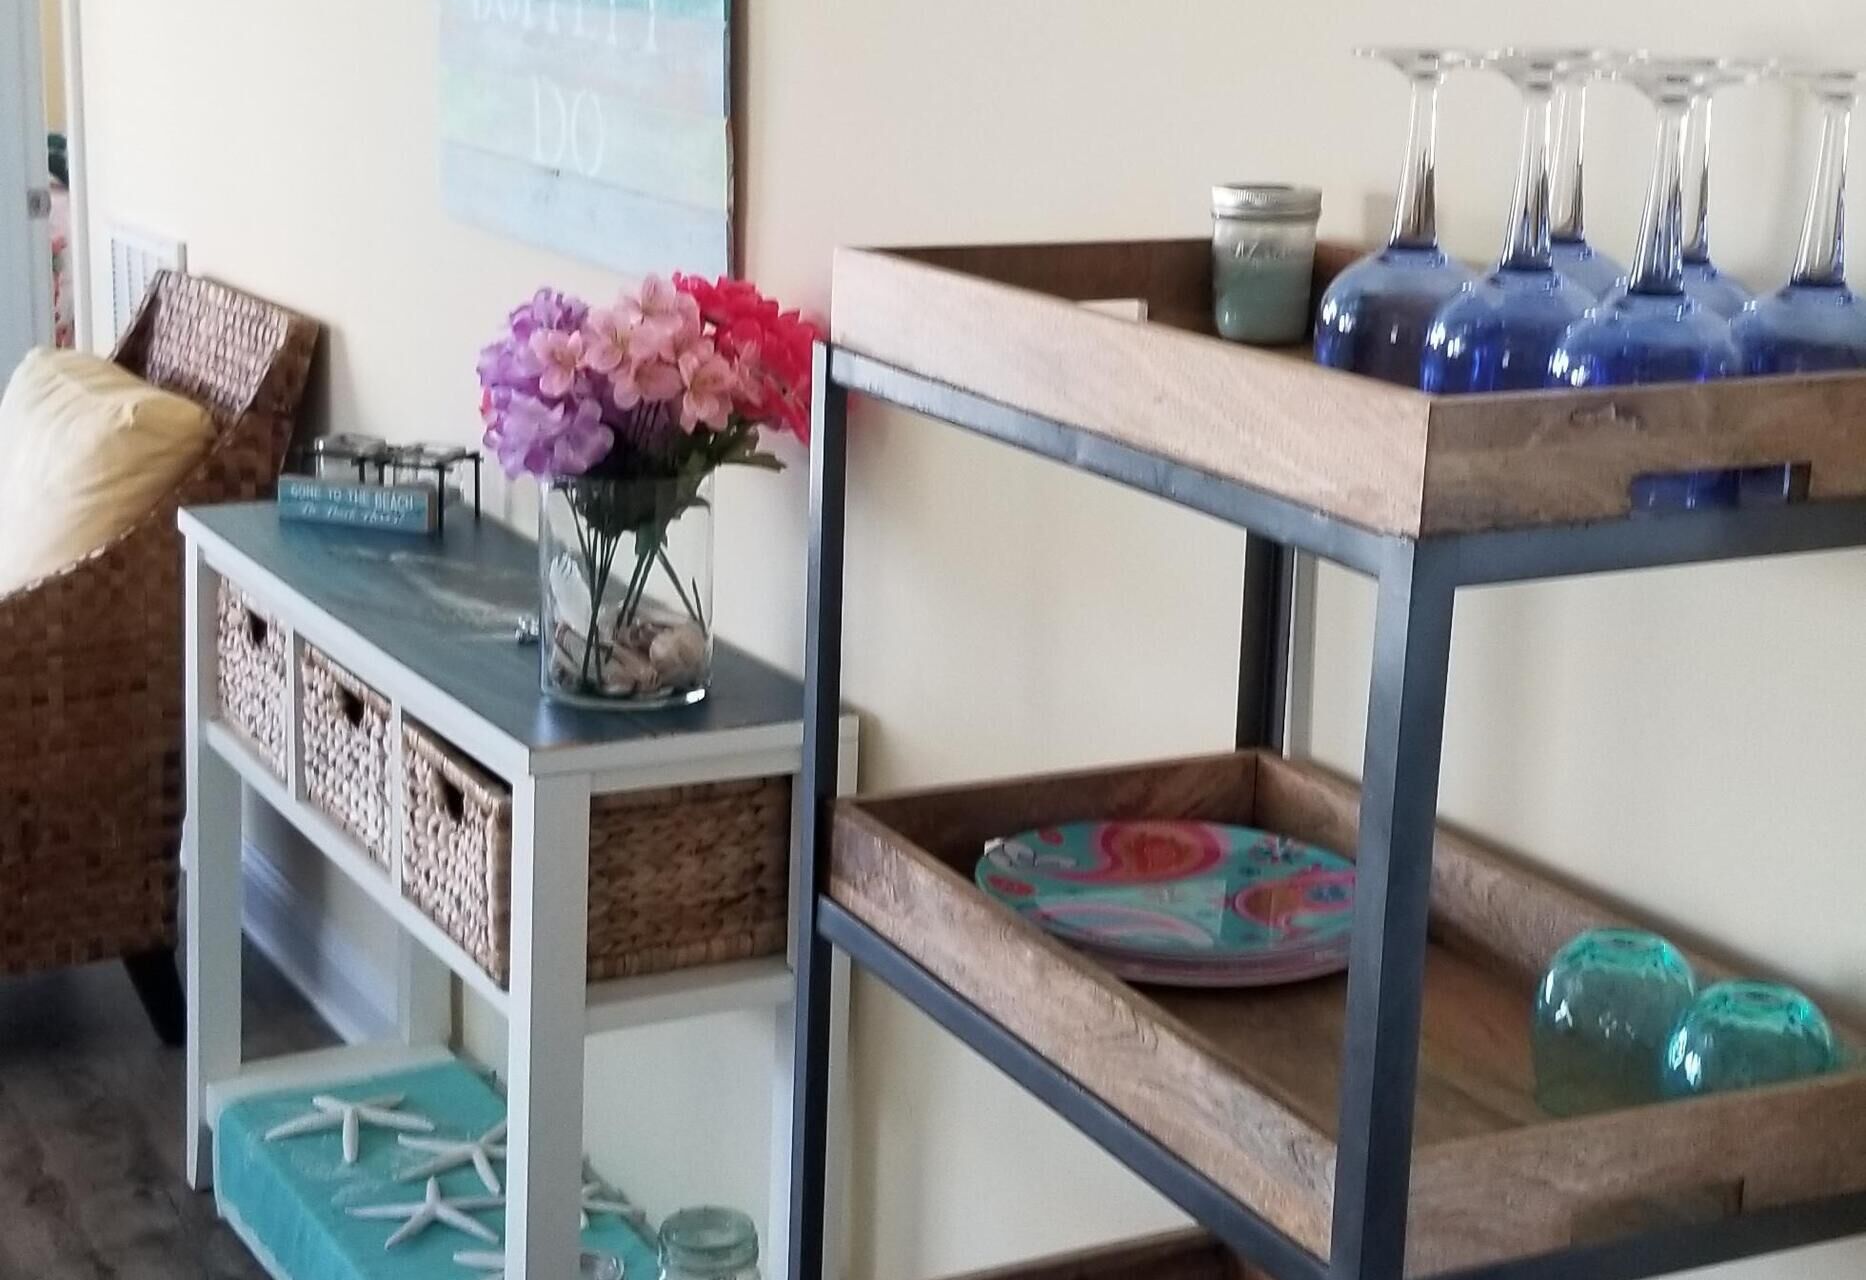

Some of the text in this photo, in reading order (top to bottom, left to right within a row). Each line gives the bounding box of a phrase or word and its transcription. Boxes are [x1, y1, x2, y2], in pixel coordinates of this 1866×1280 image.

[528, 74, 605, 178] DO
[290, 482, 414, 513] GONE TO THE BEACH
